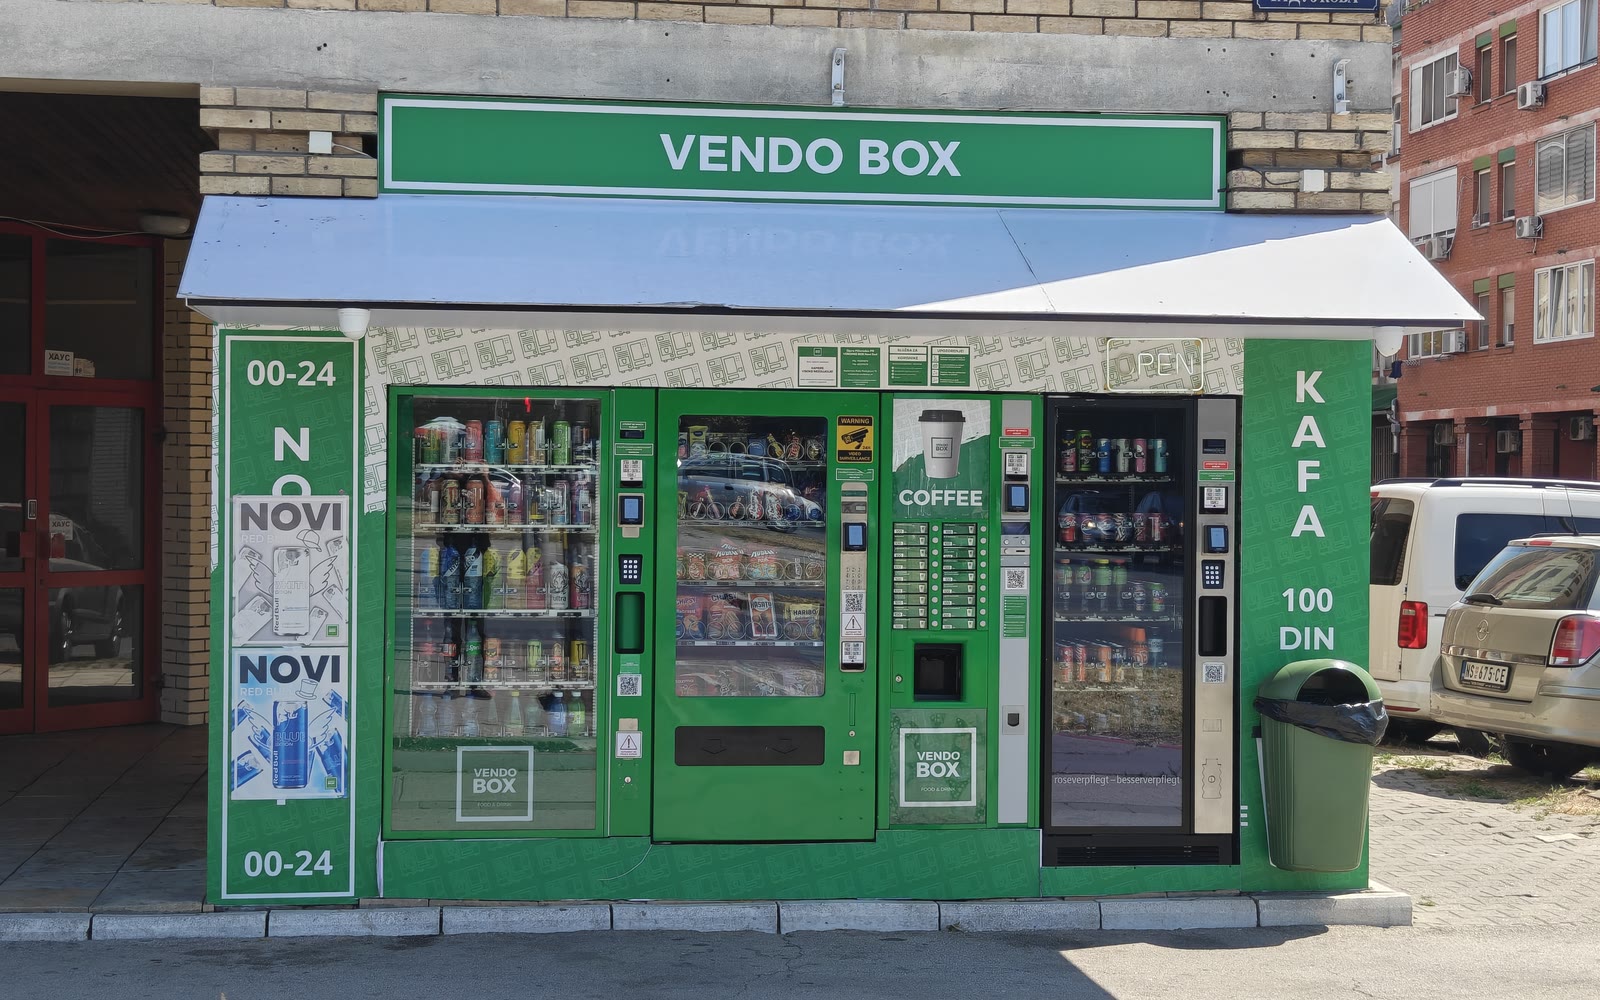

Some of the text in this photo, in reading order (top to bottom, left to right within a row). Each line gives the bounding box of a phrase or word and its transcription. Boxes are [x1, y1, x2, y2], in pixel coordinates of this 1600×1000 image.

[659, 133, 962, 177] VENDO BOX
[48, 352, 71, 362] ХАУС
[247, 360, 336, 387] 00-24
[1290, 371, 1327, 537] KAFA
[899, 489, 983, 507] COFFEE
[51, 520, 70, 528] ХАУС
[241, 502, 341, 531] NOVI
[241, 534, 263, 543] RED
[1282, 587, 1333, 612] 100
[1279, 626, 1334, 651] DIN
[240, 655, 340, 684] NOVI
[1465, 663, 1475, 679] NS
[240, 687, 263, 697] RED
[917, 751, 960, 761] VENDO
[473, 768, 517, 778] VENDO
[916, 761, 960, 778] BOX
[473, 778, 517, 794] BOX
[1117, 774, 1180, 787] besserverpflegt
[244, 850, 333, 877] 00-24
